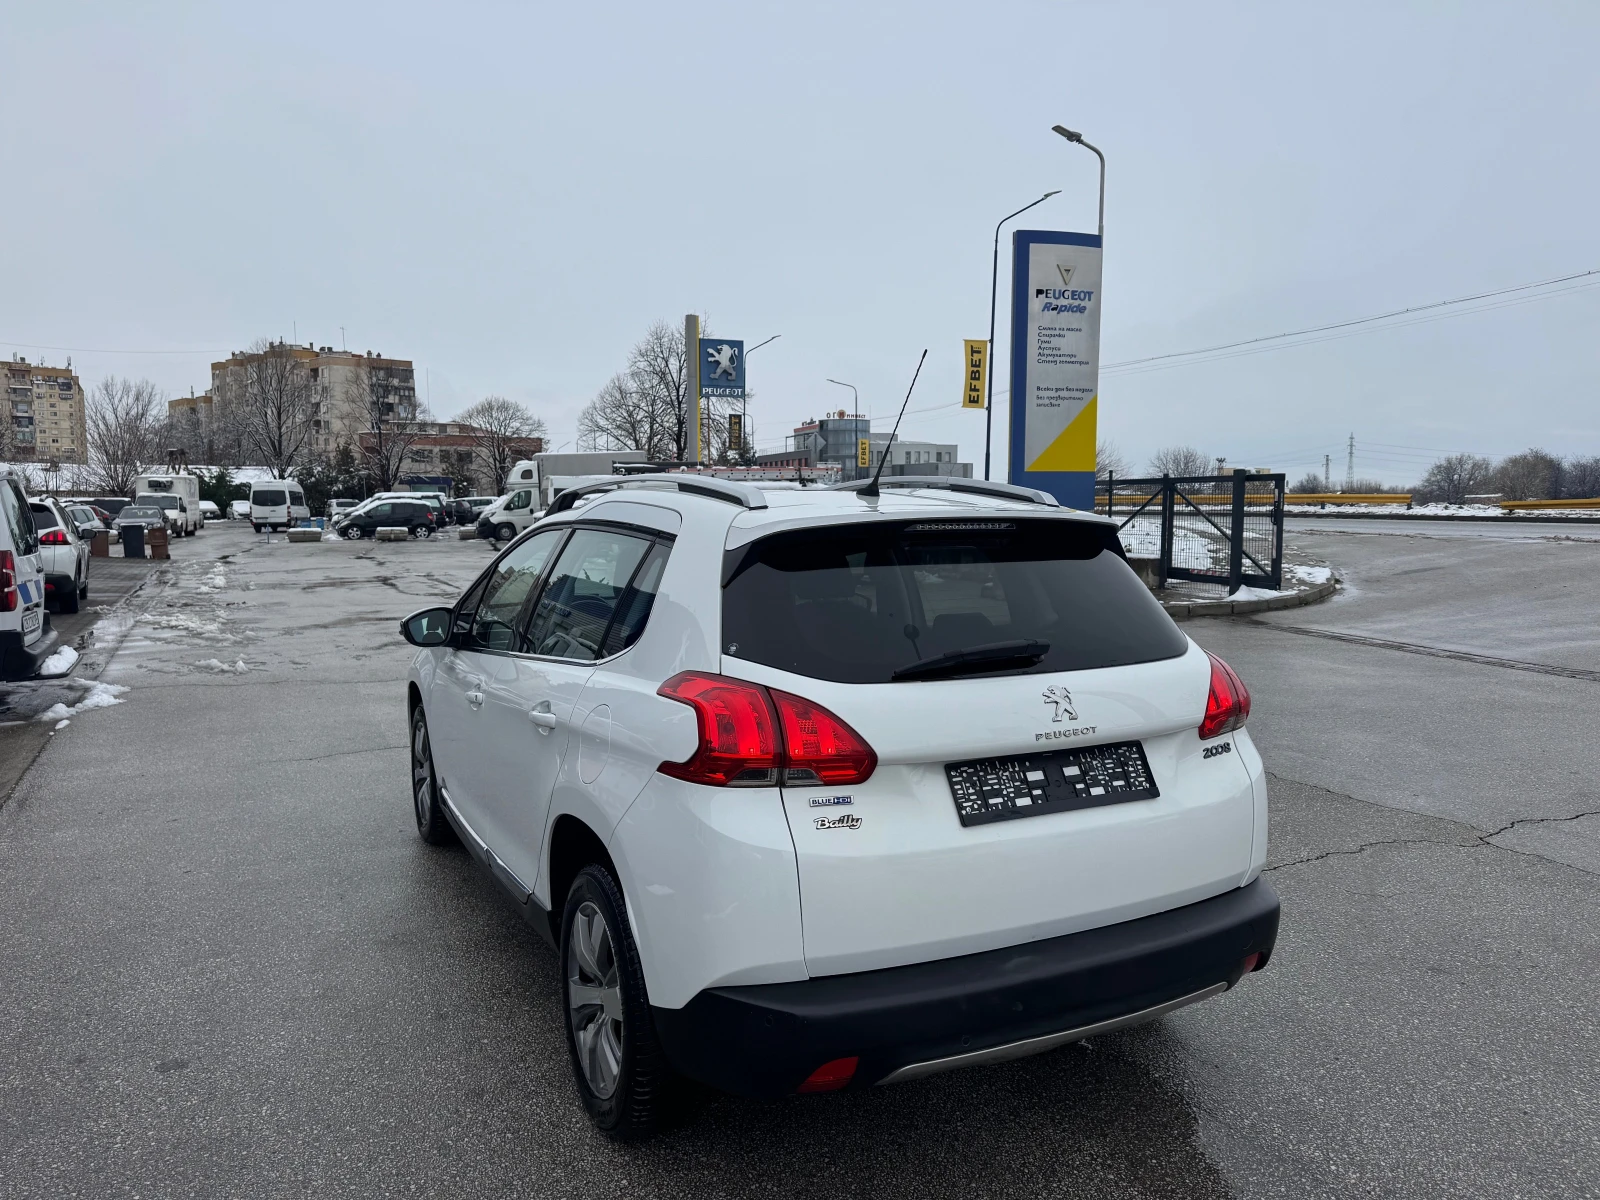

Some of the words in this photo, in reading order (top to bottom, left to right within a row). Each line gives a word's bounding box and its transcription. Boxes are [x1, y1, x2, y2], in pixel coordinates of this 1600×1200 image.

[1035, 288, 1094, 301] PEUGEOT
[1041, 301, 1087, 314] Rapide
[968, 344, 982, 404] EFBET
[702, 387, 743, 396] PEUGEOT
[1035, 725, 1098, 742] PEUGEOT
[1202, 741, 1232, 760] 2008
